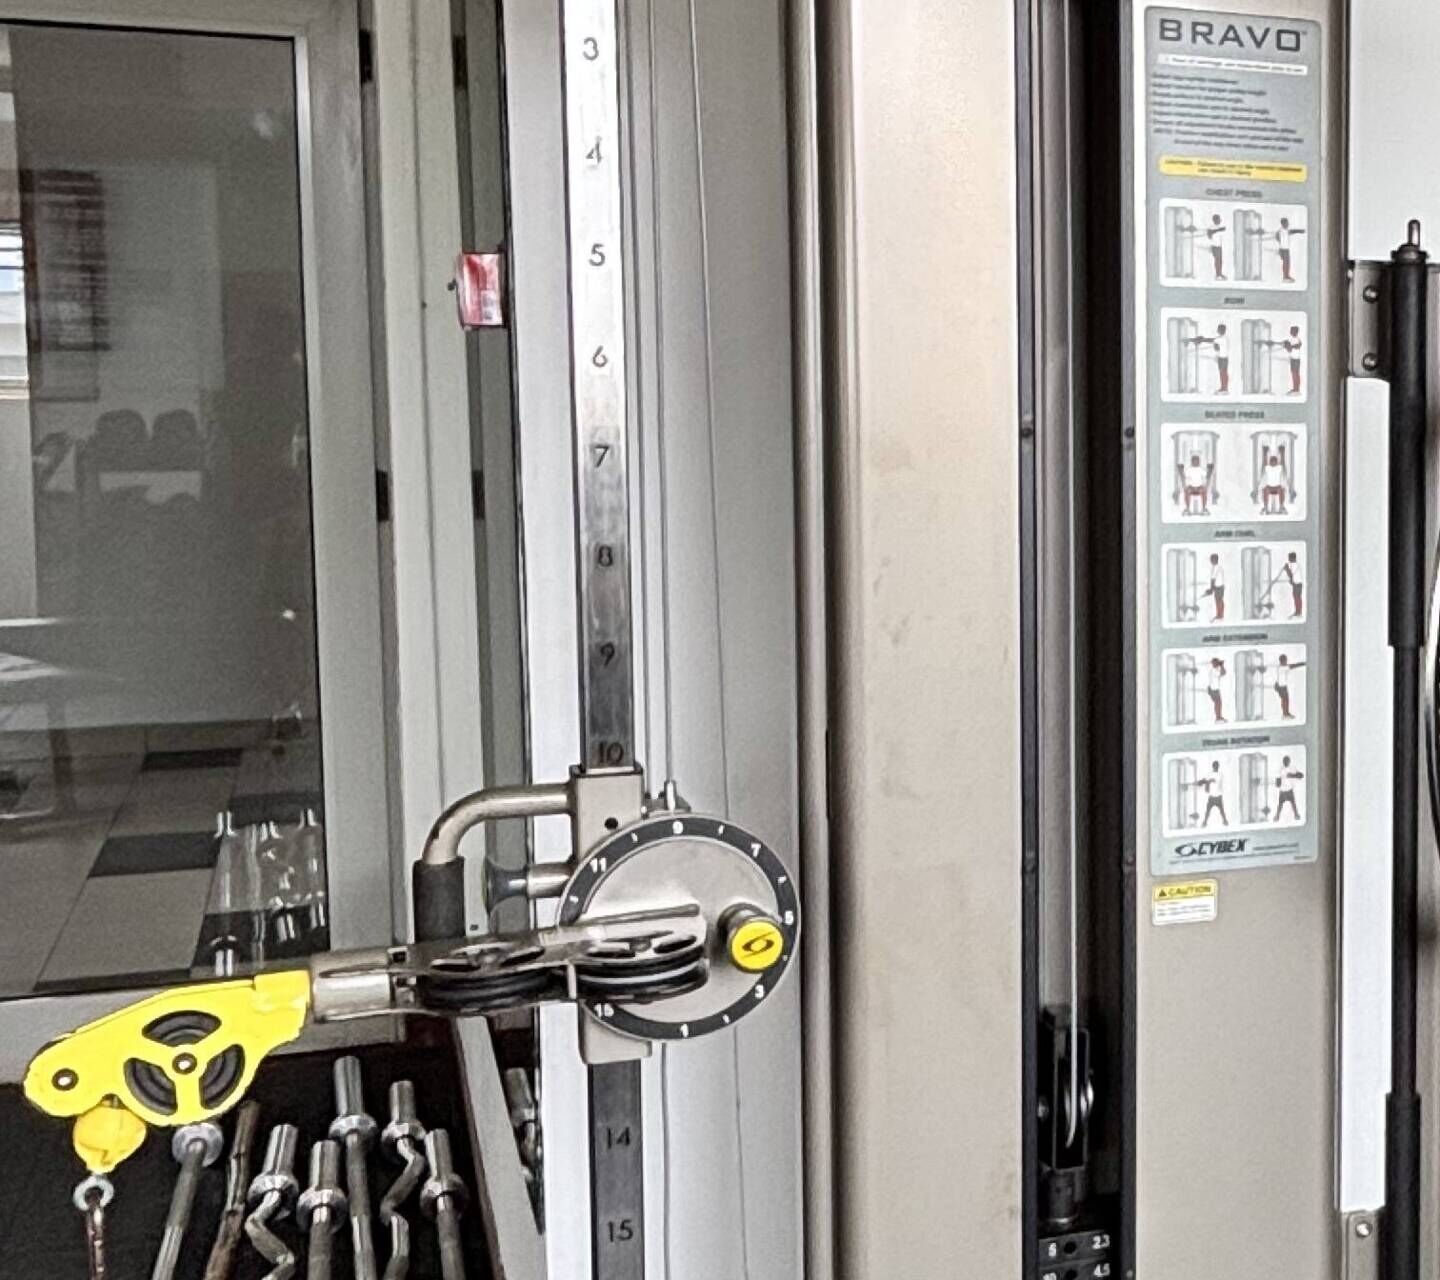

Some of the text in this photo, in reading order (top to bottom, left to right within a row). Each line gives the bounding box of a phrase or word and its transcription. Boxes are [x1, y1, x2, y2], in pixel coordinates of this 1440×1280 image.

[1159, 18, 1301, 52] BRAVO
[583, 37, 599, 61] 3
[585, 137, 603, 164] 4
[589, 243, 605, 267] 5
[592, 345, 608, 368] 6
[592, 445, 610, 468] 7
[597, 545, 613, 568] 8
[600, 642, 615, 668] 9
[598, 742, 623, 765] 10
[751, 843, 762, 857] 7
[1197, 839, 1248, 855] CYBEX
[605, 1126, 631, 1149] 14
[607, 1220, 634, 1242] 15
